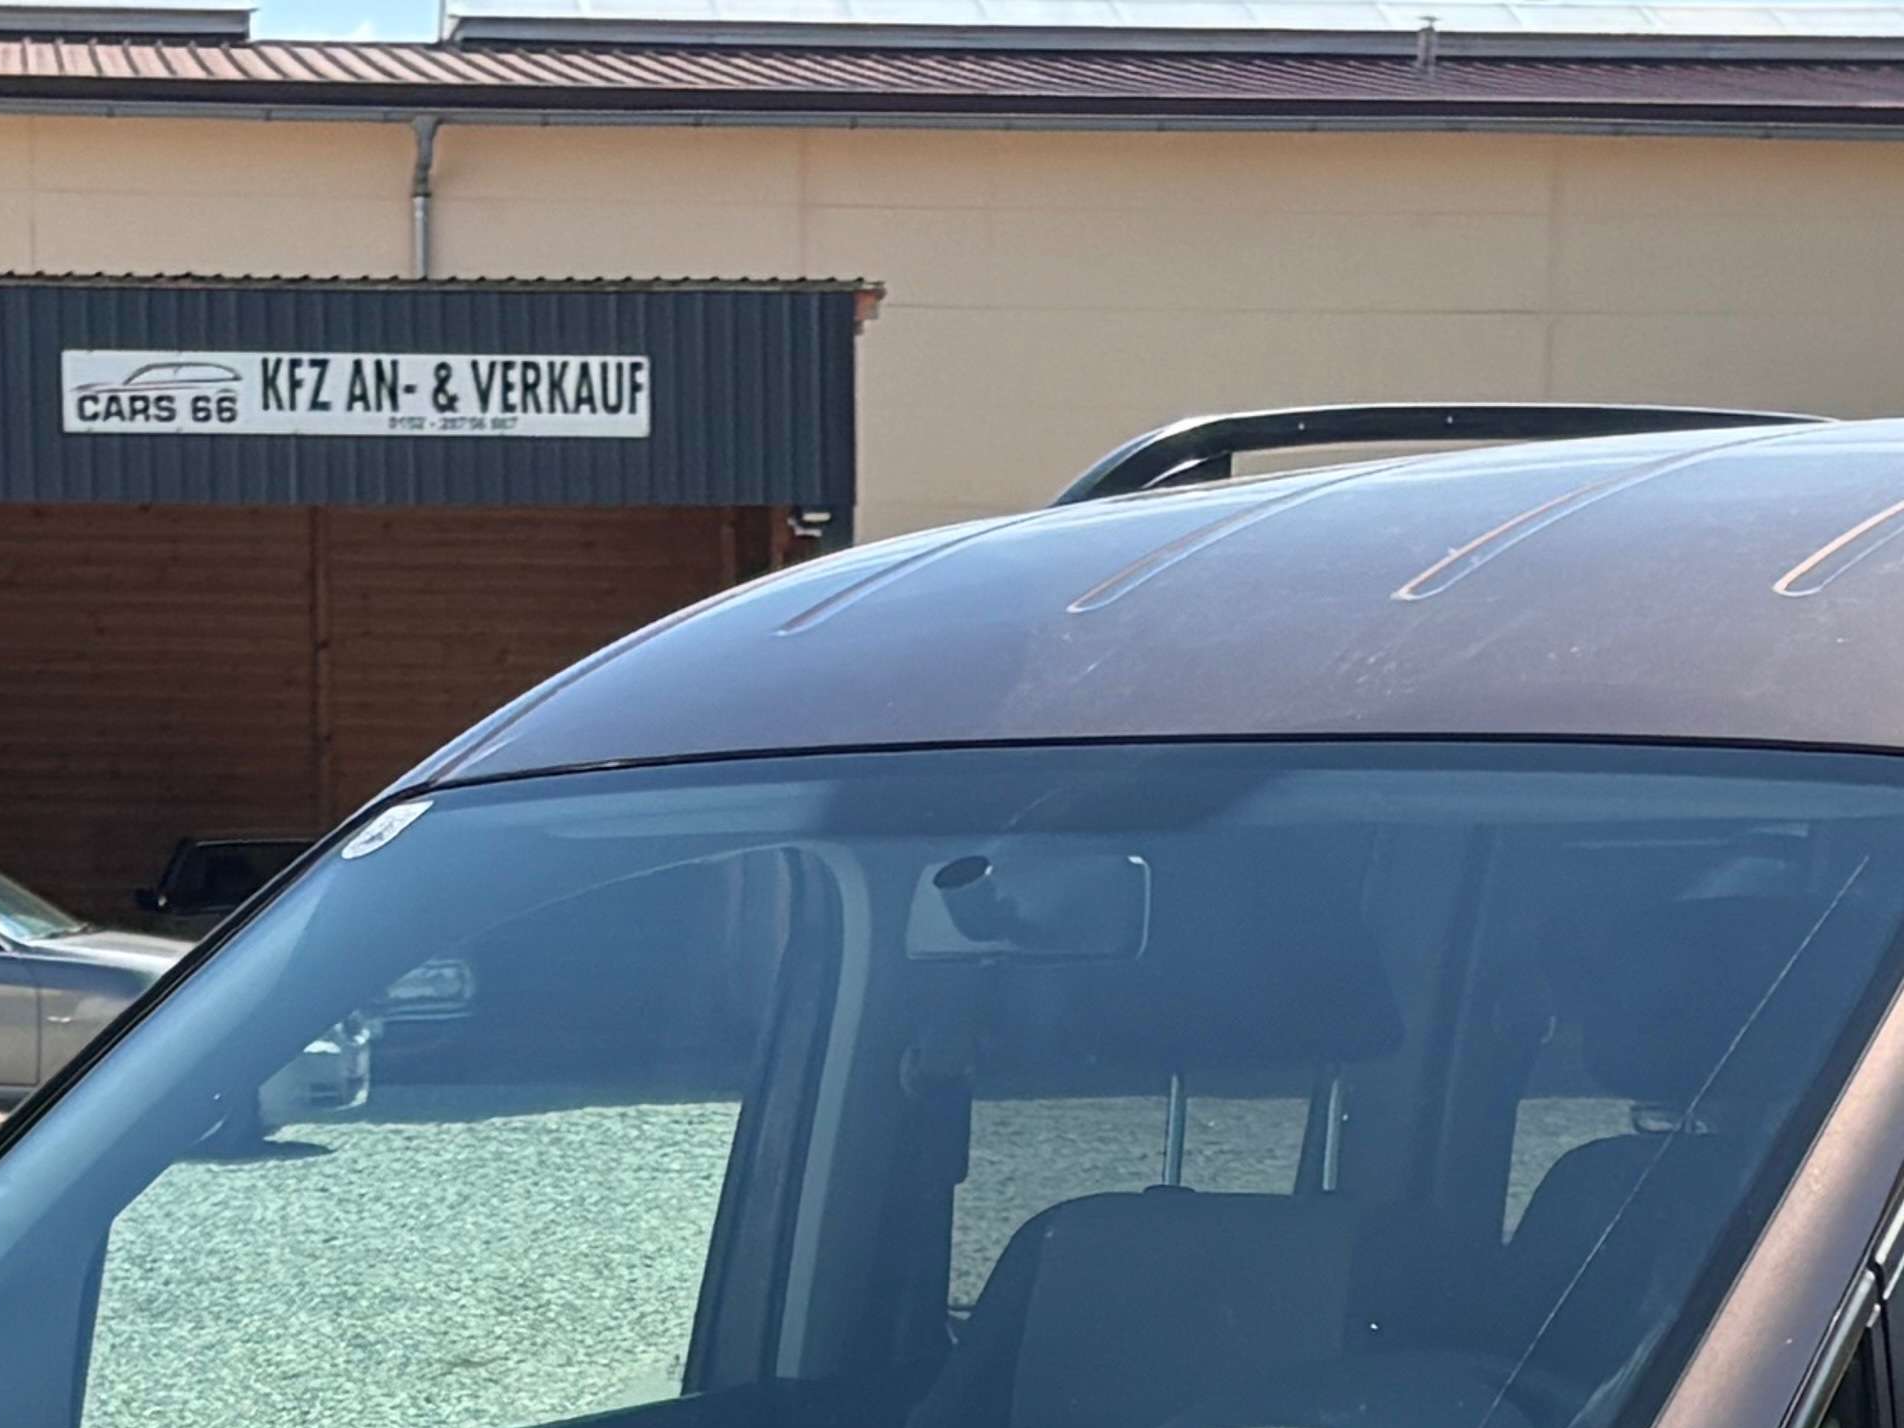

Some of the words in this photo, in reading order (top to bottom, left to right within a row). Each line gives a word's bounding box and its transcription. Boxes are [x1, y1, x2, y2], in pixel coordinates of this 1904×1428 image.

[261, 358, 330, 411] KFZ
[347, 359, 417, 412] AN-
[431, 362, 459, 413] &
[470, 360, 645, 414] VERKAUF
[76, 395, 177, 422] CARS
[191, 396, 238, 423] 66
